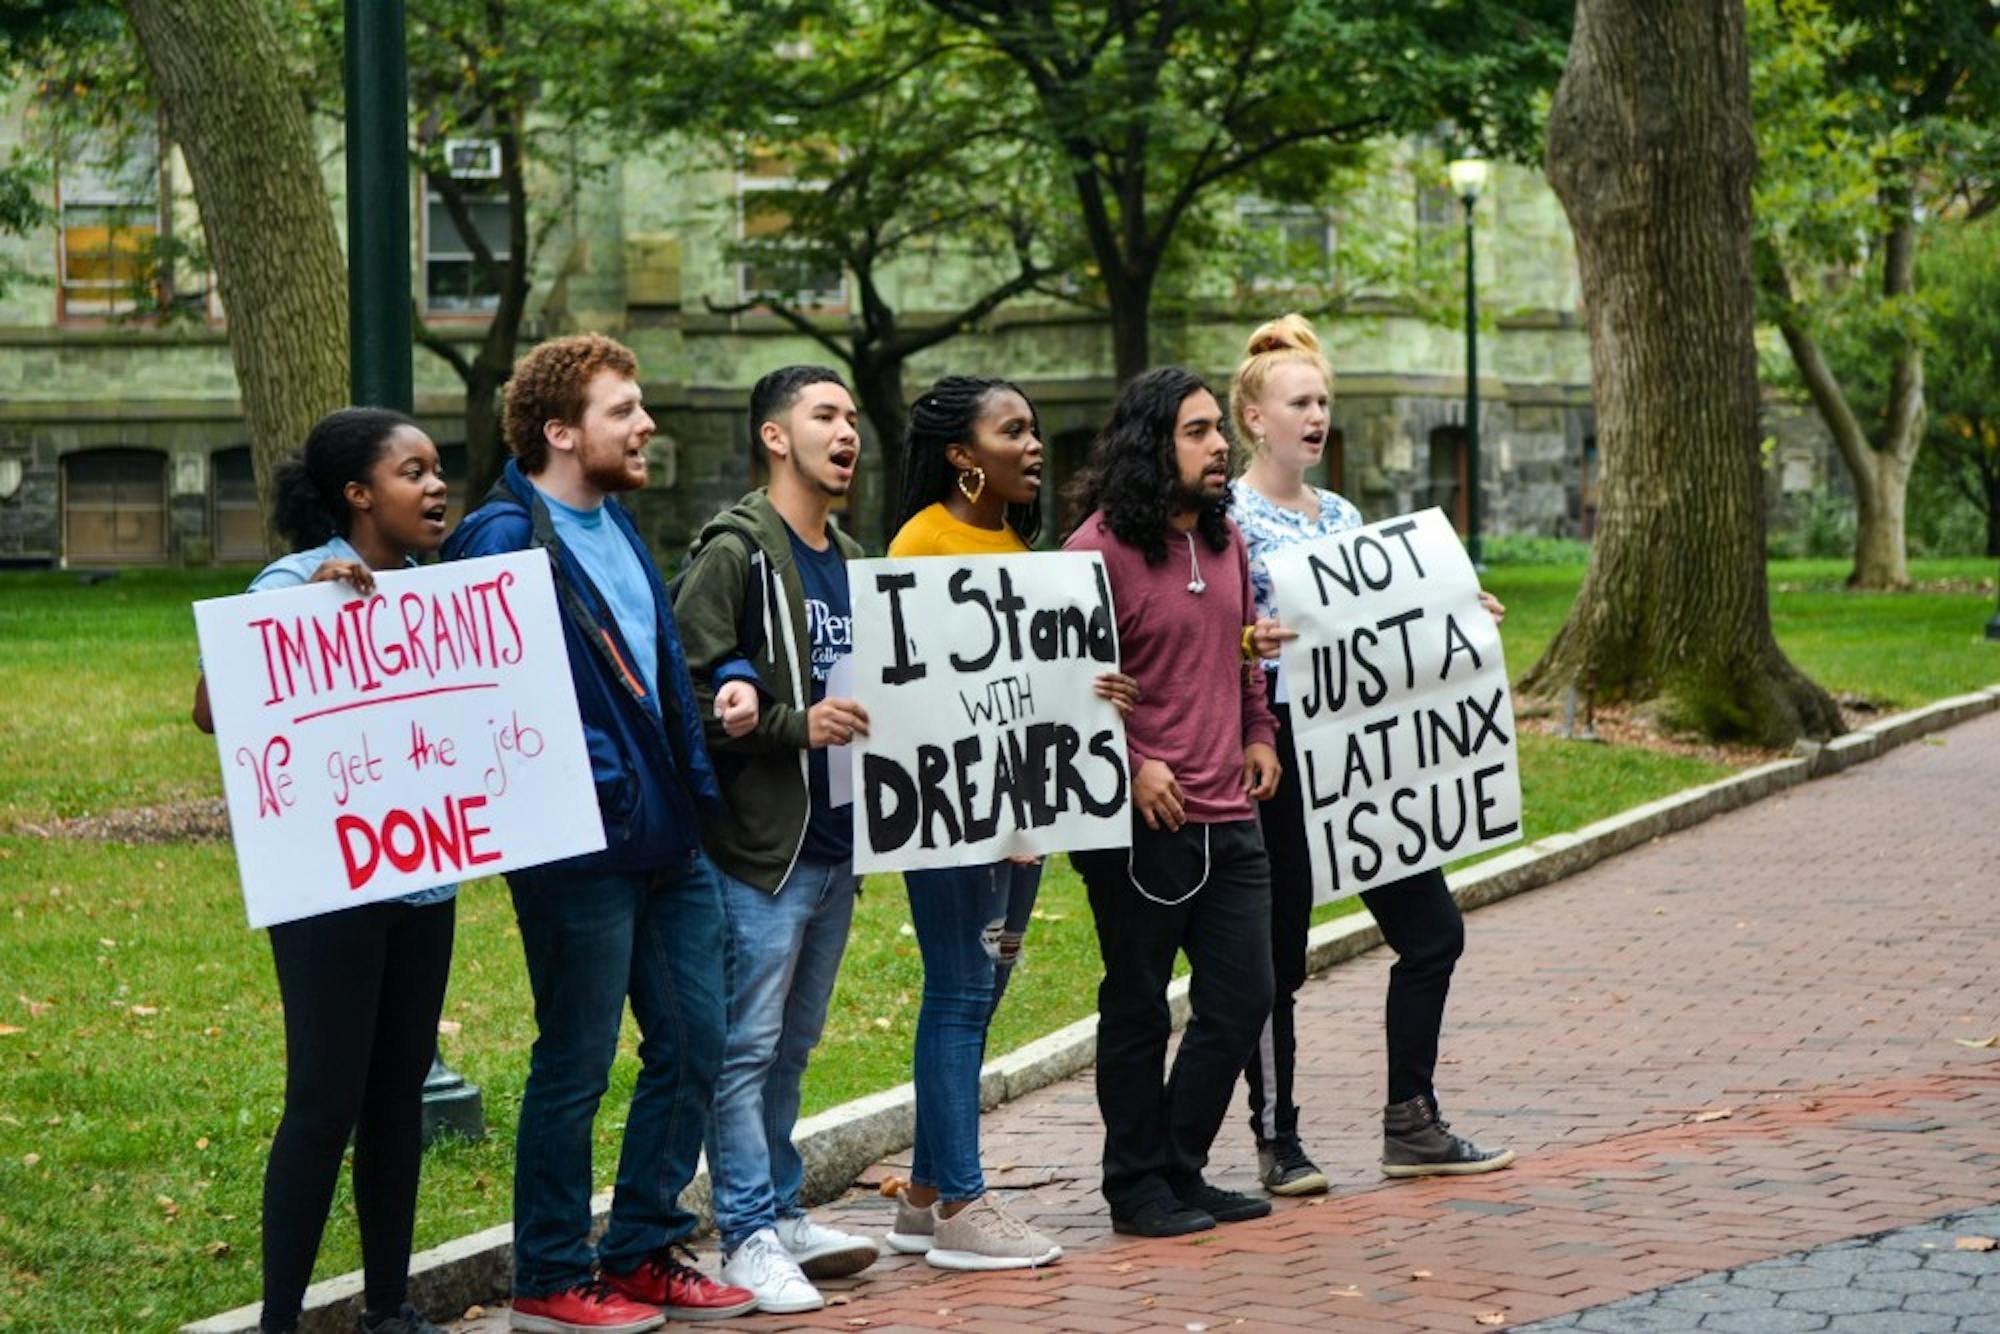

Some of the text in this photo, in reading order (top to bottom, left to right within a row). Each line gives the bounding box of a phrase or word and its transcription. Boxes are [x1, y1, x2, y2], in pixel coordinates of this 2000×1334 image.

[1308, 520, 1426, 606] NOT
[248, 571, 523, 706] IMMIGRANTS
[875, 561, 1116, 685] I Stand
[1302, 607, 1482, 719] JUST A
[959, 672, 1034, 726] WITH
[1305, 688, 1510, 809] LATINX
[236, 709, 544, 818] We get the job
[863, 721, 1128, 855] DREAMERS
[335, 795, 502, 890] DONE
[1324, 763, 1518, 891] ISSUE
